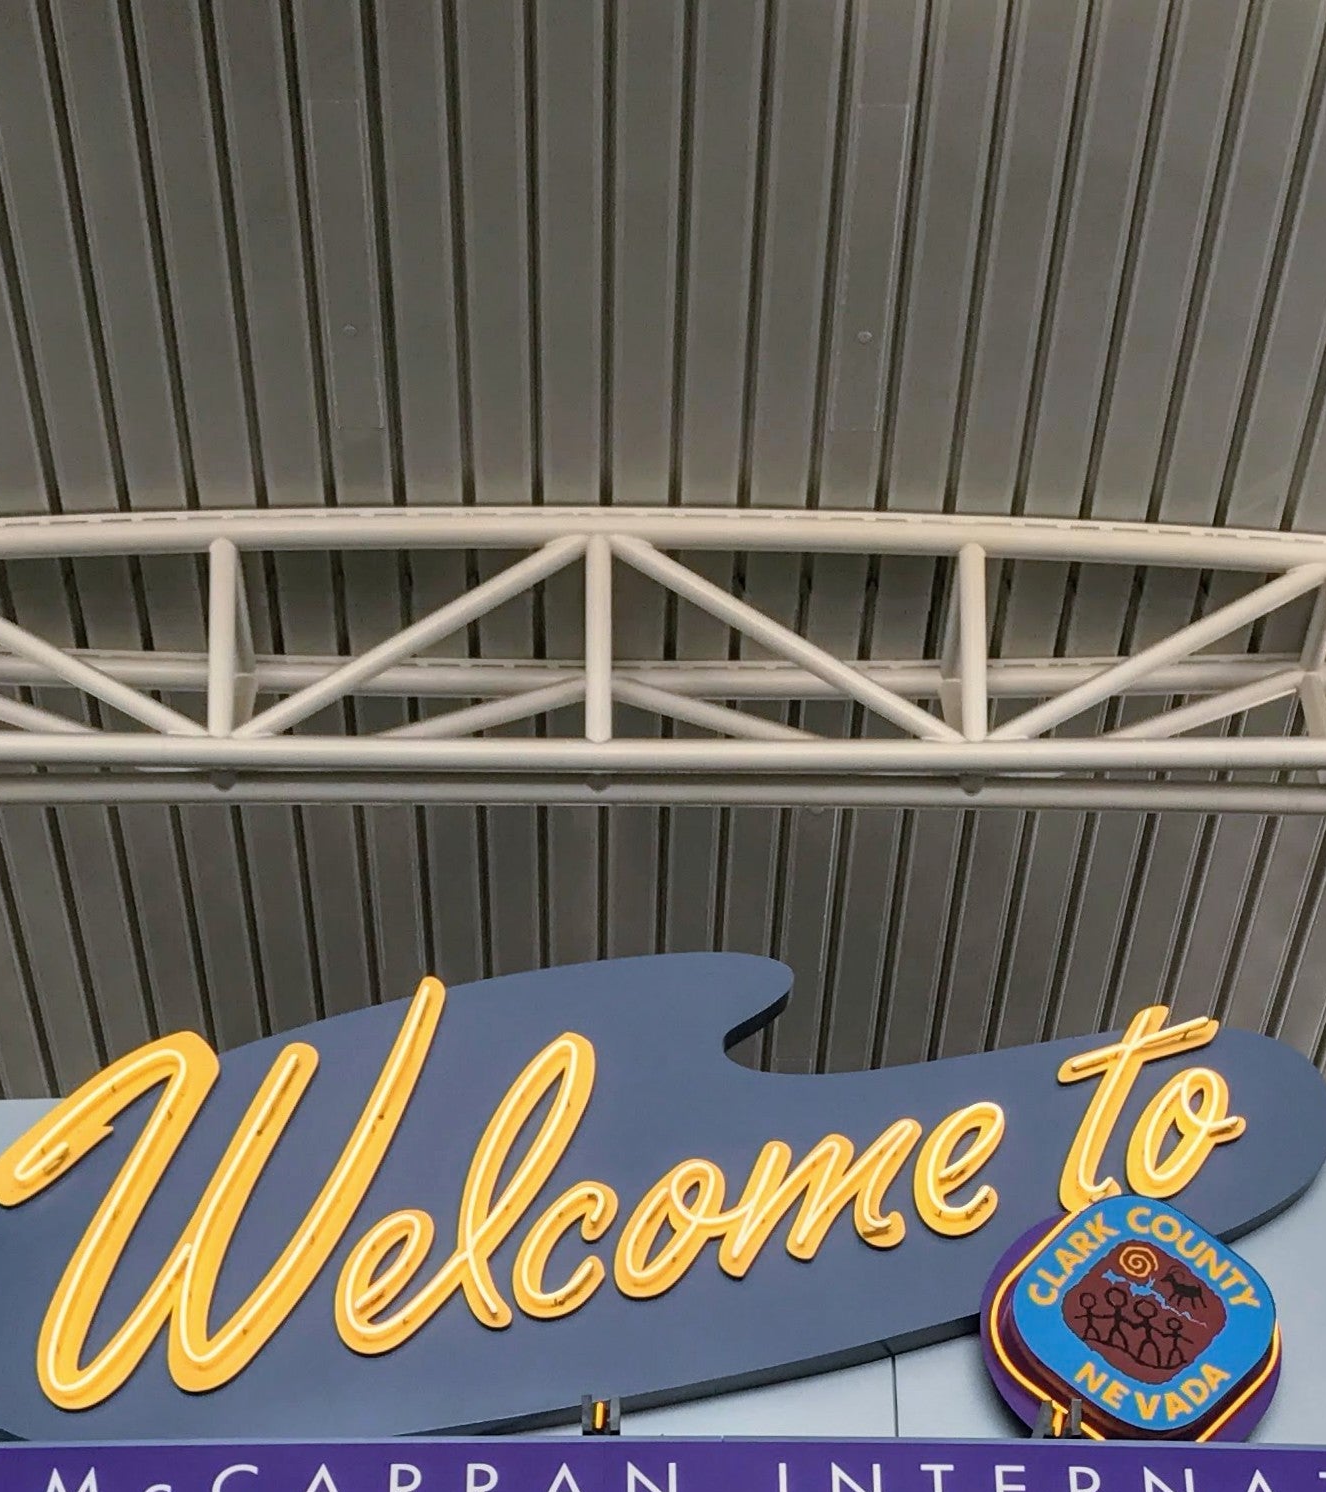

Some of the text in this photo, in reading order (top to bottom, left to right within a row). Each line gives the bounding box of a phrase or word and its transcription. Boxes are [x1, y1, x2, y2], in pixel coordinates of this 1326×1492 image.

[1058, 1005, 1247, 1213] to
[1027, 1206, 1261, 1308] CLARK COUNTY
[1074, 1361, 1232, 1421] NEVADA
